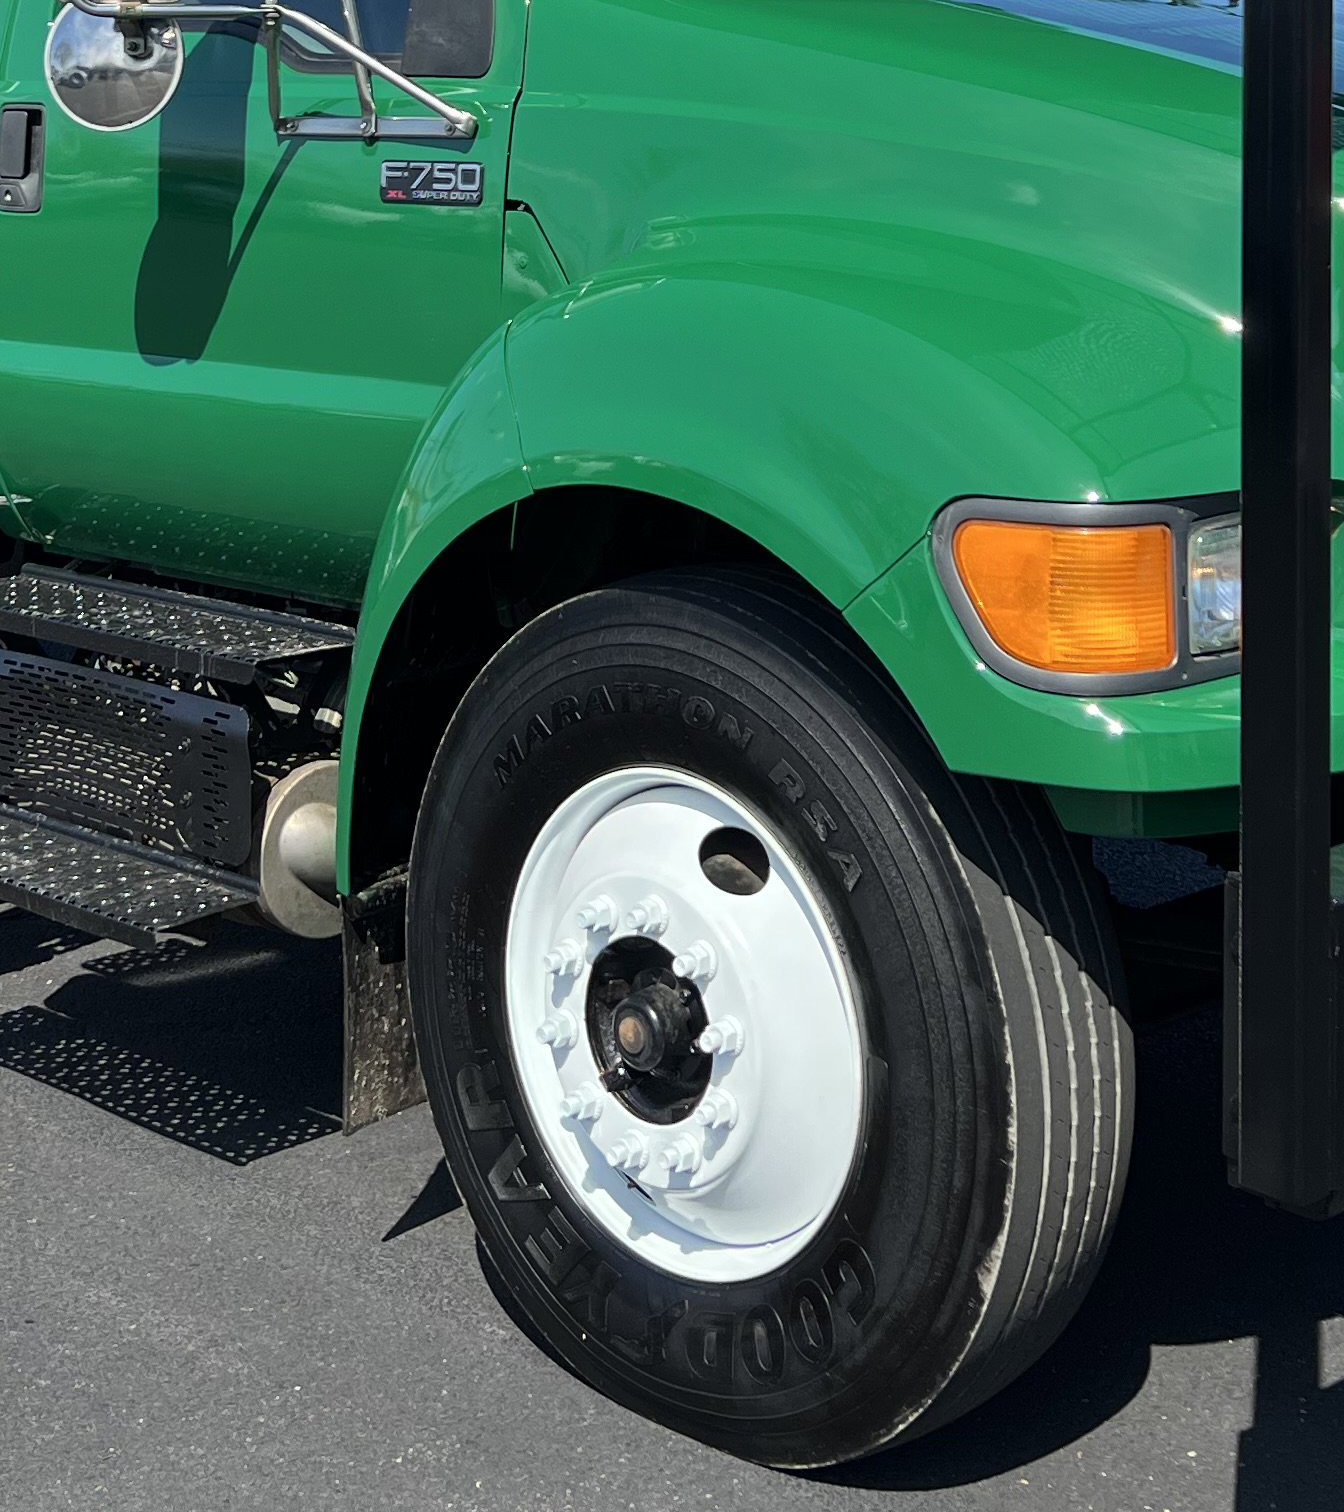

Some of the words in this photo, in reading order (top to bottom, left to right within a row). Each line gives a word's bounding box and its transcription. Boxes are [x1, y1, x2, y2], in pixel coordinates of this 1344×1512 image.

[387, 190, 407, 199] XL
[412, 190, 447, 200] SUPER
[450, 192, 480, 201] DUTY
[491, 681, 754, 790] MARATHON
[767, 757, 864, 894] RSA
[454, 1058, 878, 1386] GOODYEAR
